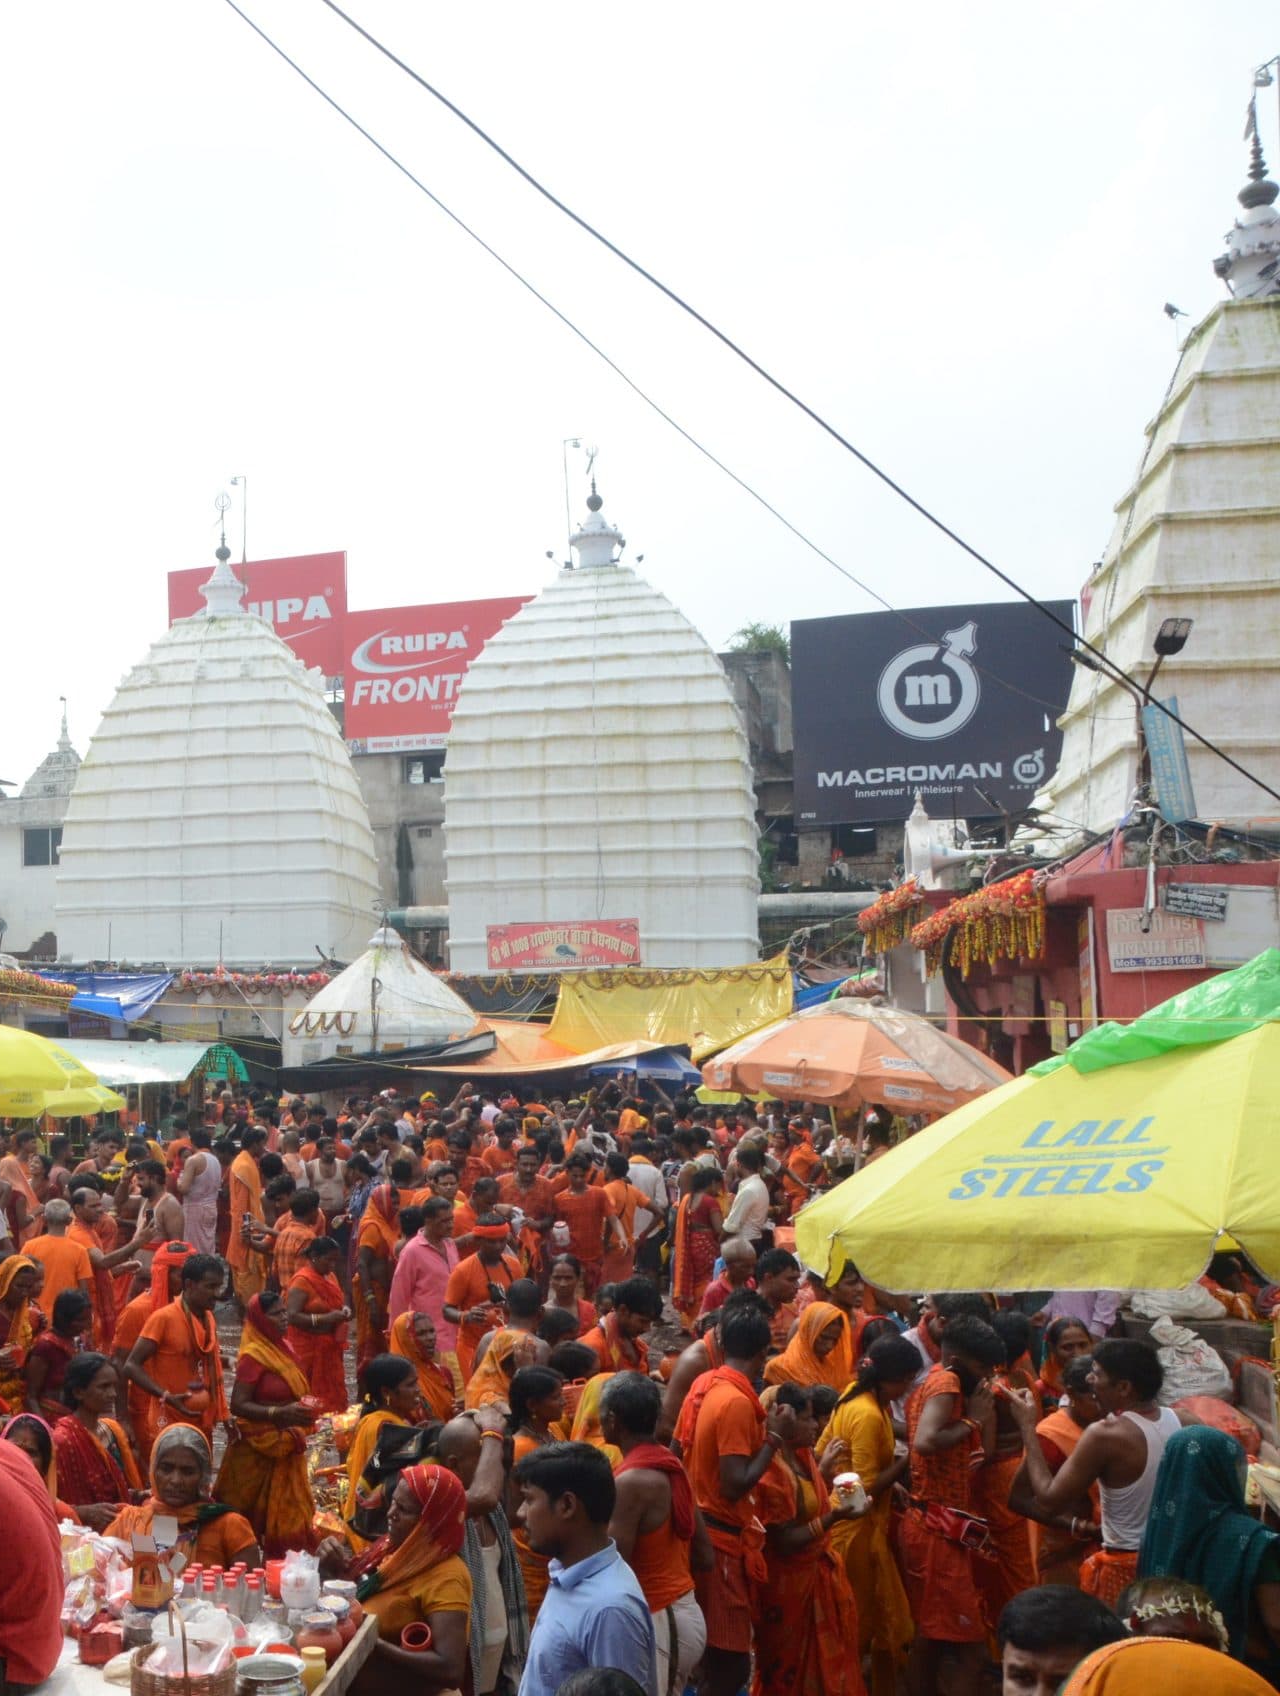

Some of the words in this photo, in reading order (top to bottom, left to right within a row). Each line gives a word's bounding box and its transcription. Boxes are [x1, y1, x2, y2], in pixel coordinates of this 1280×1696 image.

[247, 594, 333, 624] UPA
[381, 630, 469, 656] RUPA
[351, 673, 462, 706] FRONT
[904, 673, 952, 706] m
[817, 762, 1002, 788] MACROMAN
[855, 786, 904, 799] Innerwear
[913, 784, 964, 796] Athleisure
[1021, 1116, 1156, 1148] LALL
[948, 1159, 1165, 1201] STEELS
